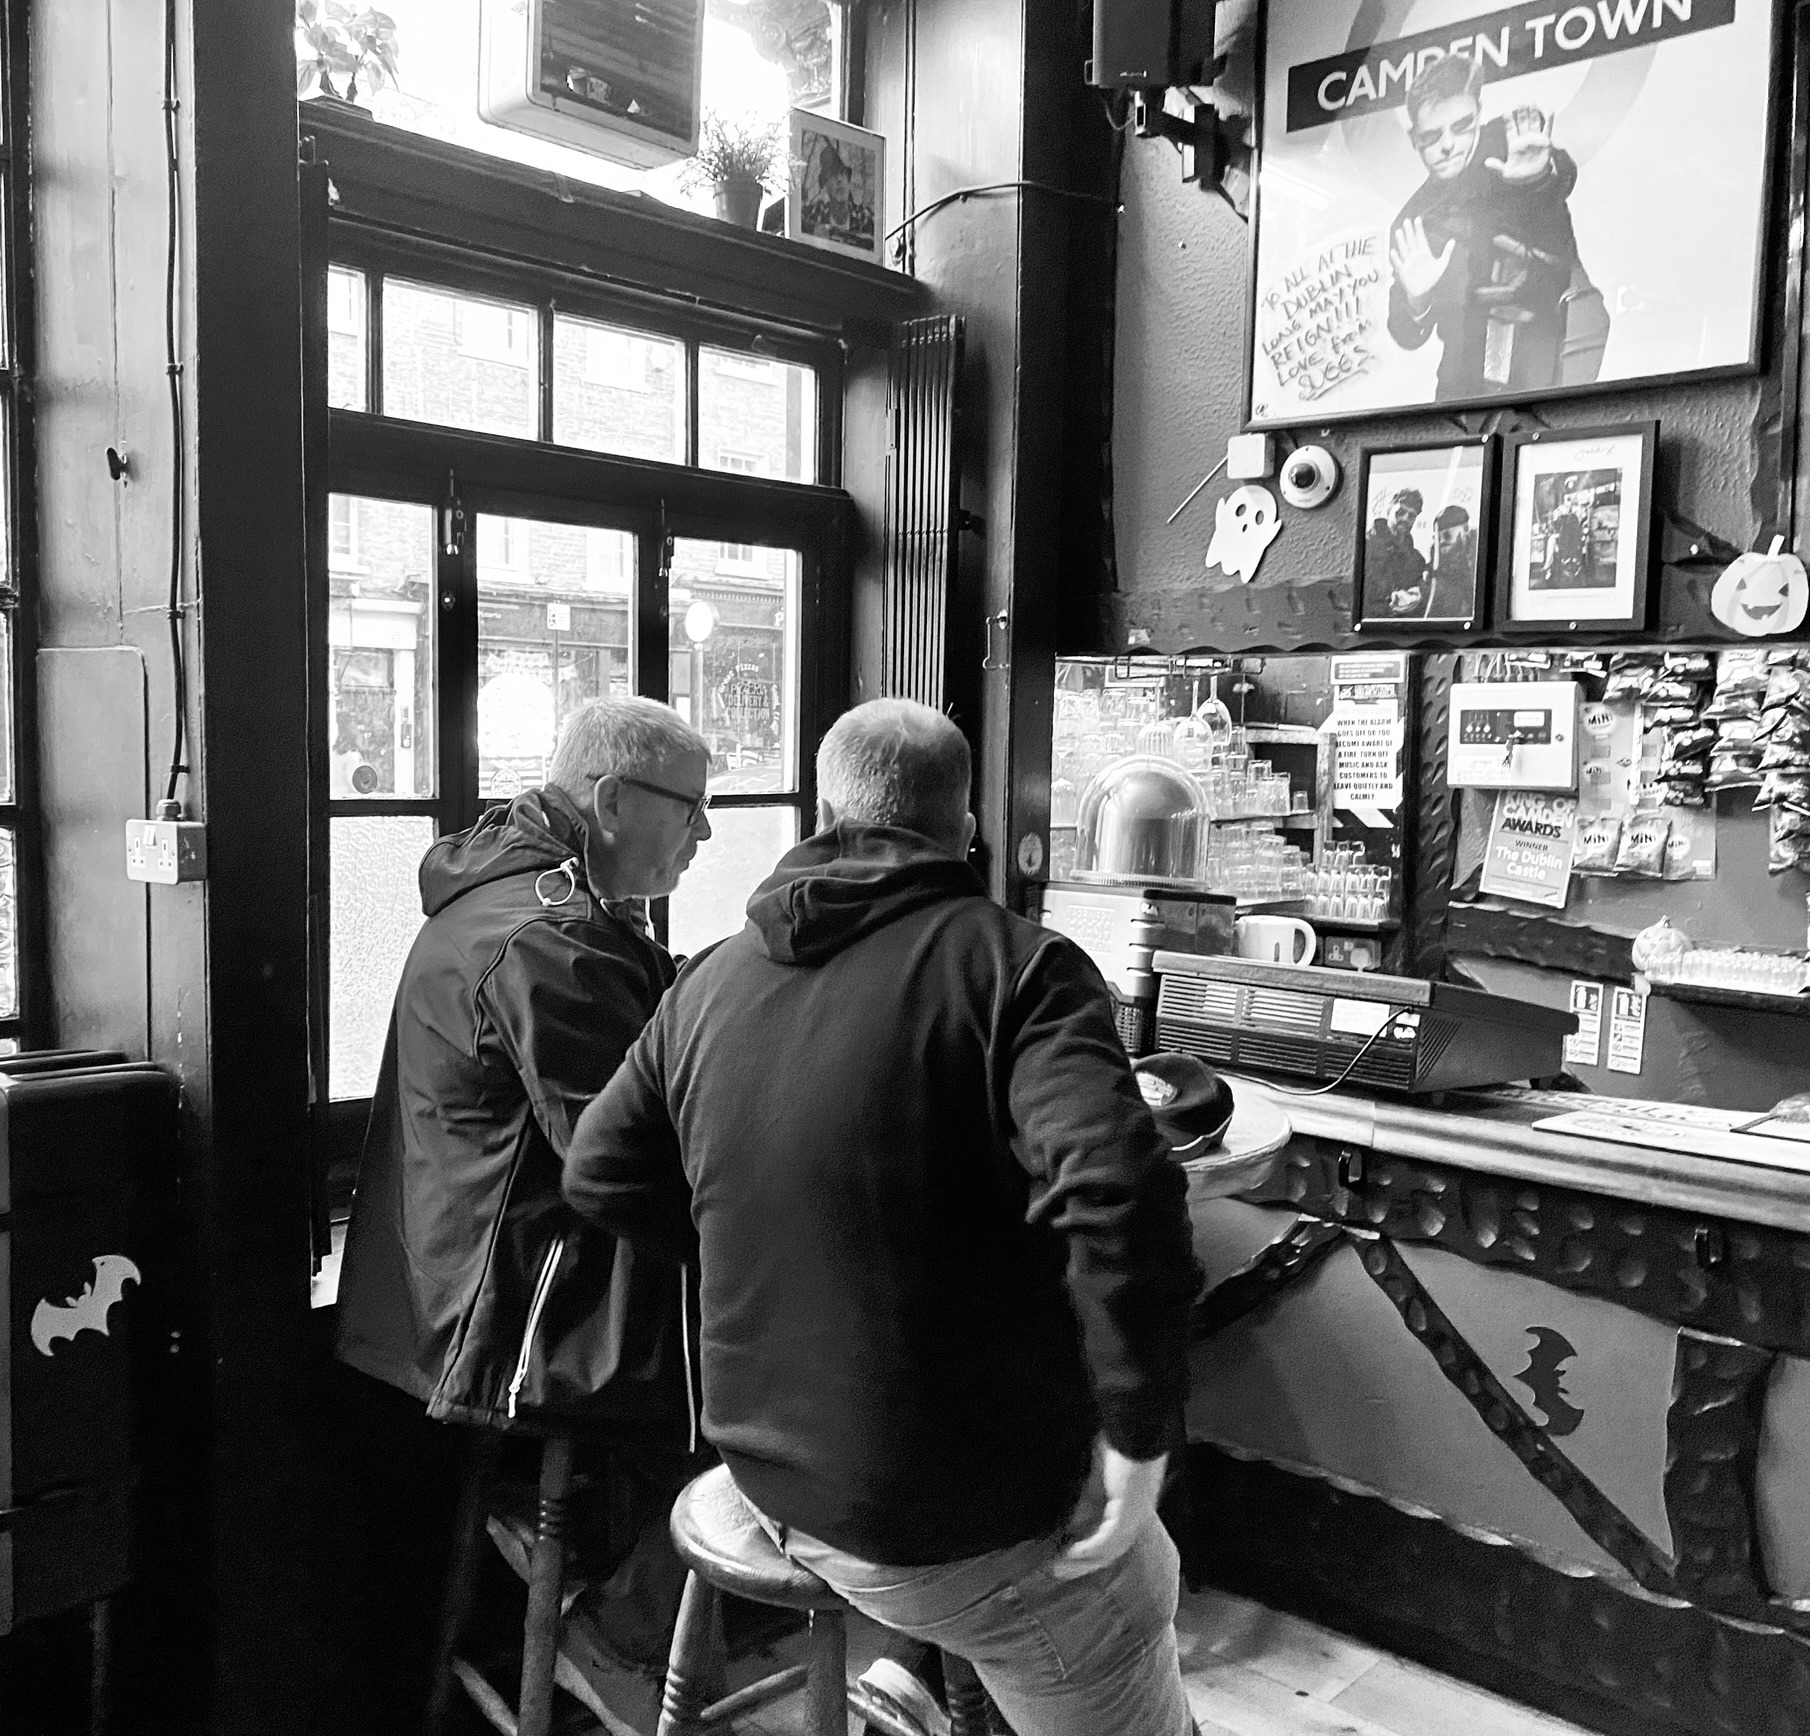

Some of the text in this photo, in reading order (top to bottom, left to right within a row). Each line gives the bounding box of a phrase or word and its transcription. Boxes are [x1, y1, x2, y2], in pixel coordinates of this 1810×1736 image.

[1525, 0, 1692, 59] TOWN
[1262, 288, 1281, 310] TO
[1284, 267, 1310, 293] ALL
[1281, 264, 1353, 320] DUBLIN
[1262, 269, 1379, 356] LONG MAY YOU
[1277, 351, 1324, 387] LOVE
[727, 695, 762, 706] DELIVERY
[727, 707, 770, 719] COLLECTION
[1334, 782, 1352, 790] LEAVE
[1505, 791, 1546, 808] KING
[1503, 804, 1574, 828] CAMDEN
[1501, 818, 1562, 838] AWARDS
[1516, 840, 1548, 852] WINNER
[1496, 845, 1563, 870] The Dublin
[1506, 861, 1546, 880] Castle
